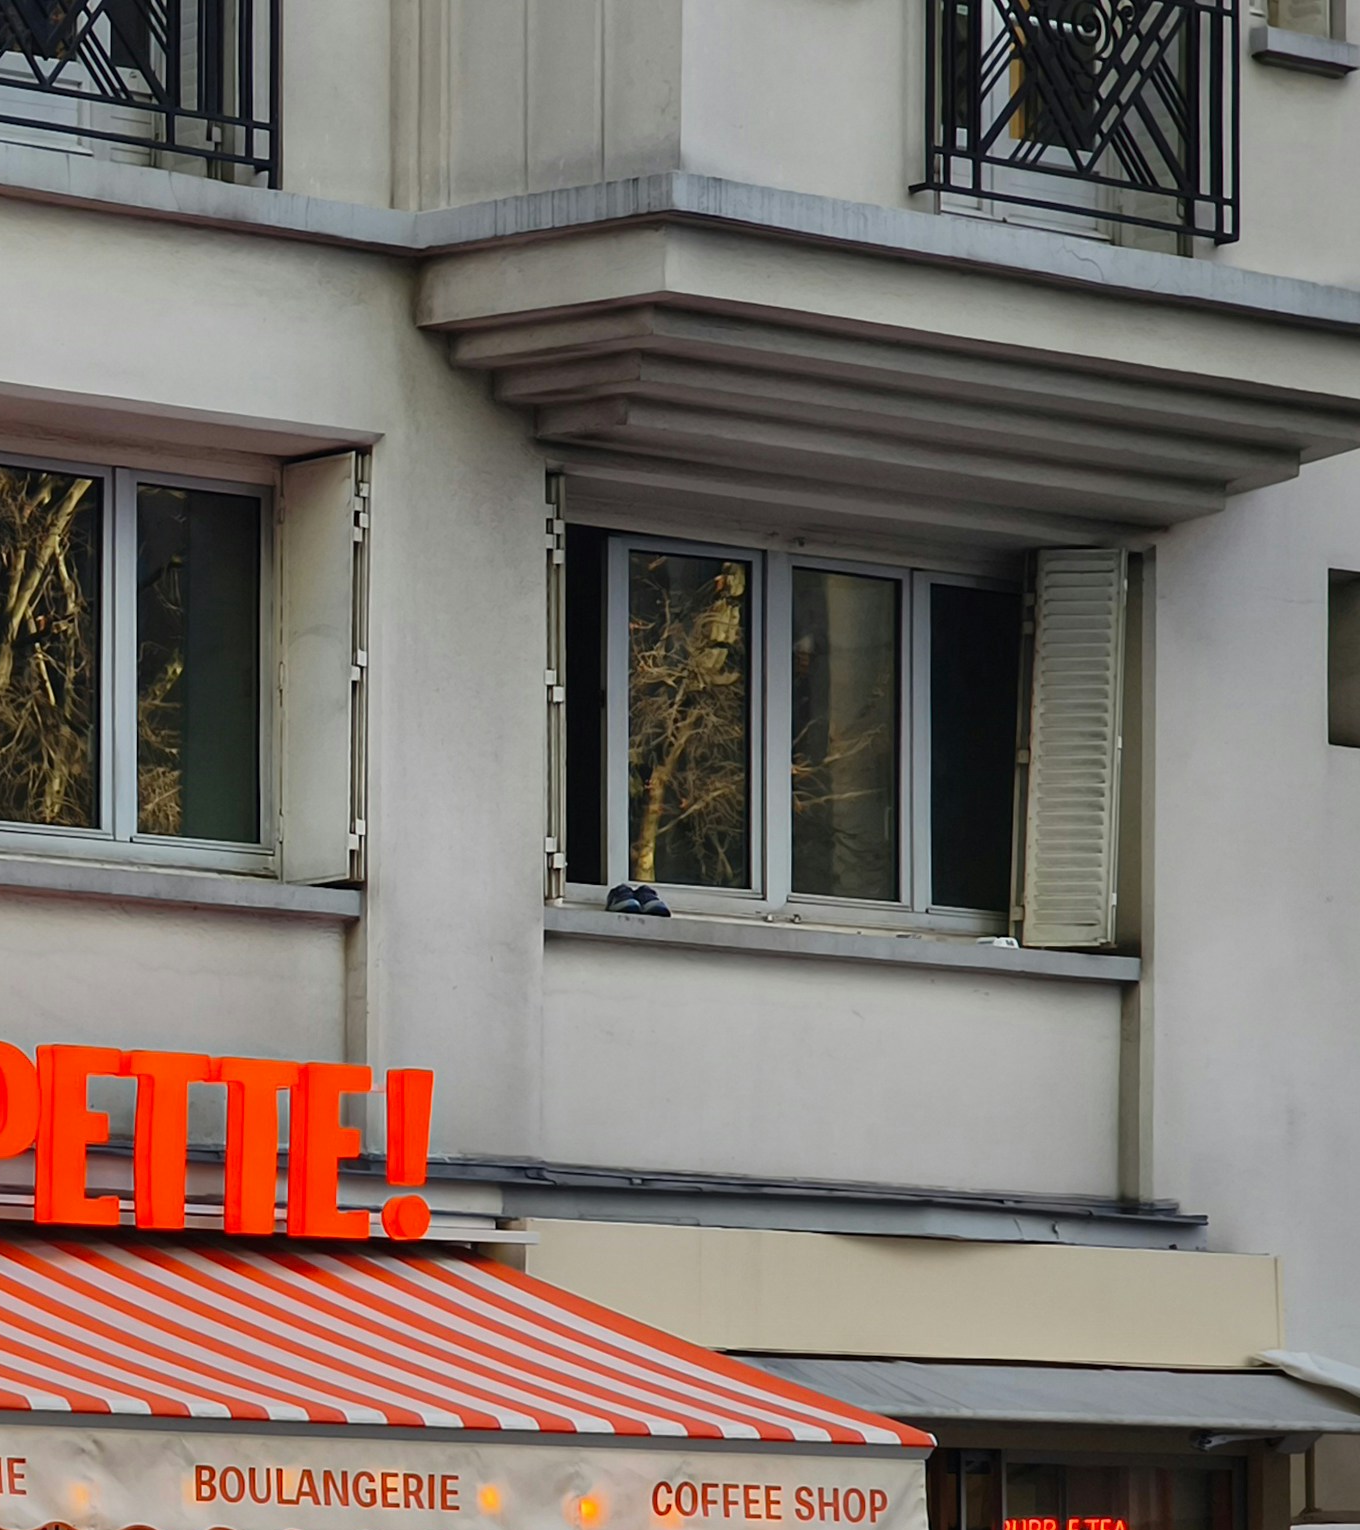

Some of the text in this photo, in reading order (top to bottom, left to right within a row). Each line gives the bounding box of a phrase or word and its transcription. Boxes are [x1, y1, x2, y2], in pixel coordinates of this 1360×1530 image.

[193, 1463, 460, 1511] BOULANGERIE
[651, 1480, 888, 1524] COFFEE SHOP
